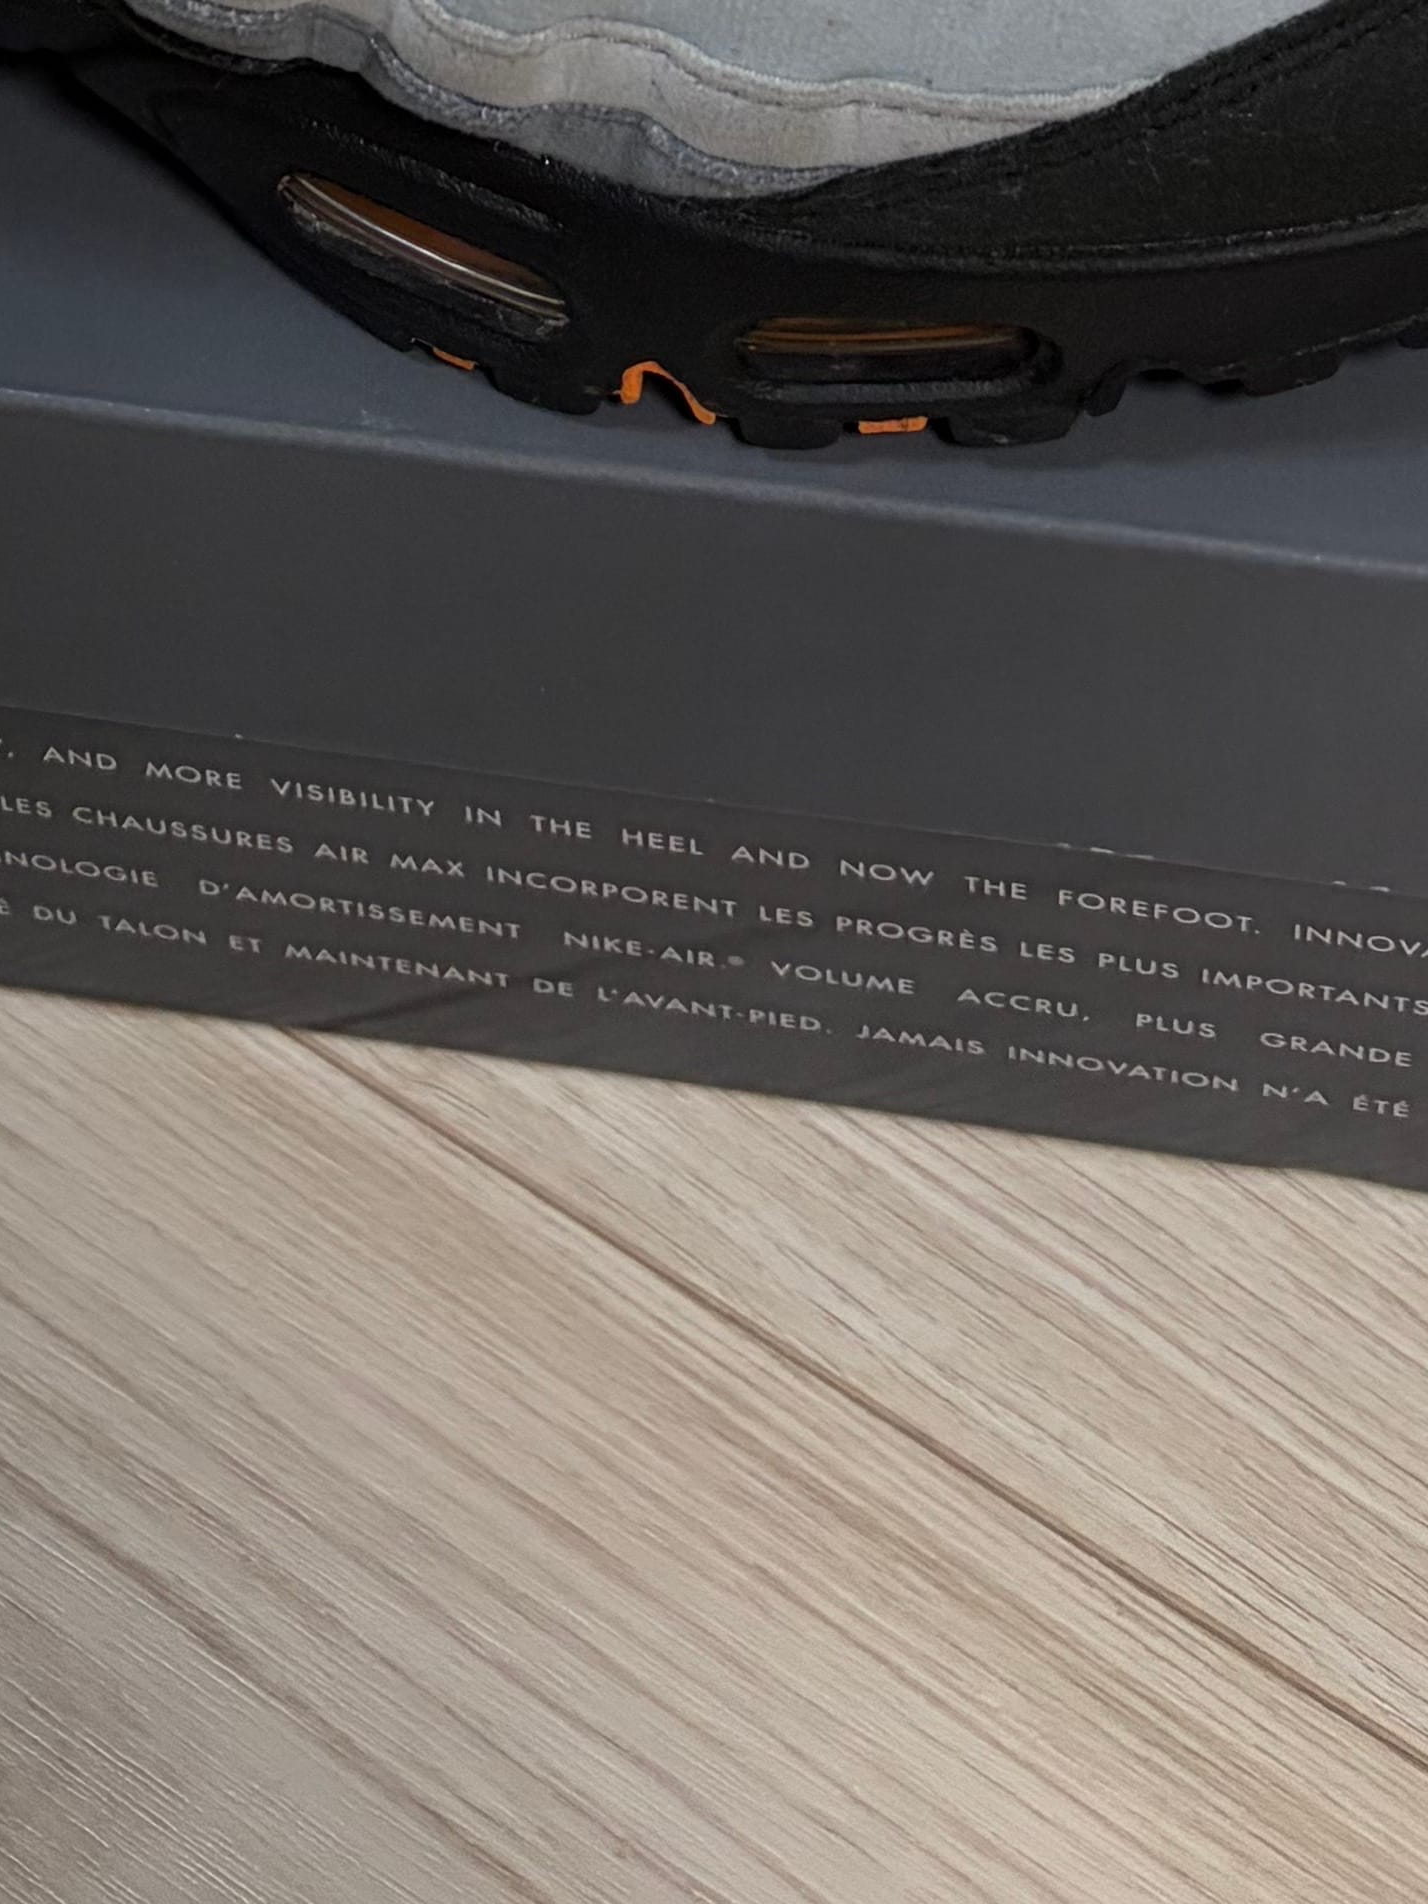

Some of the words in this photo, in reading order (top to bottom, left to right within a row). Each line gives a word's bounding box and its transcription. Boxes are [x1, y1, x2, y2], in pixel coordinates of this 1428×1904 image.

[0, 795, 53, 819] LES
[71, 806, 294, 854] CHAUSSURES
[313, 842, 370, 865] AIR
[389, 853, 465, 879] MAX
[486, 865, 738, 919] INCORPORENT
[759, 904, 814, 928] LES
[835, 915, 999, 953] PROGRÈS
[1019, 940, 1076, 964] LES
[1098, 952, 1180, 980] PLUS
[42, 745, 118, 771] AND
[145, 761, 243, 791] MORE
[269, 778, 435, 817] VISIBILITY
[464, 805, 502, 828] IN
[529, 814, 593, 840] THE
[621, 827, 704, 856] HEEL
[730, 845, 811, 870] AND
[839, 859, 935, 887] NOW
[963, 875, 1028, 901] THE
[32, 904, 77, 926] DU
[97, 915, 207, 946] TALON
[228, 934, 261, 954] ET
[284, 943, 509, 988] MAINTENANT
[533, 977, 574, 998] DE
[855, 1024, 986, 1056] JAMAIS
[1008, 1045, 1240, 1093] INNOVATION
[1352, 1093, 1410, 1119] ÉTÉ
[770, 960, 915, 995] VOLUME
[1135, 1012, 1217, 1039] PLUS
[1259, 1032, 1413, 1068] GRANDE
